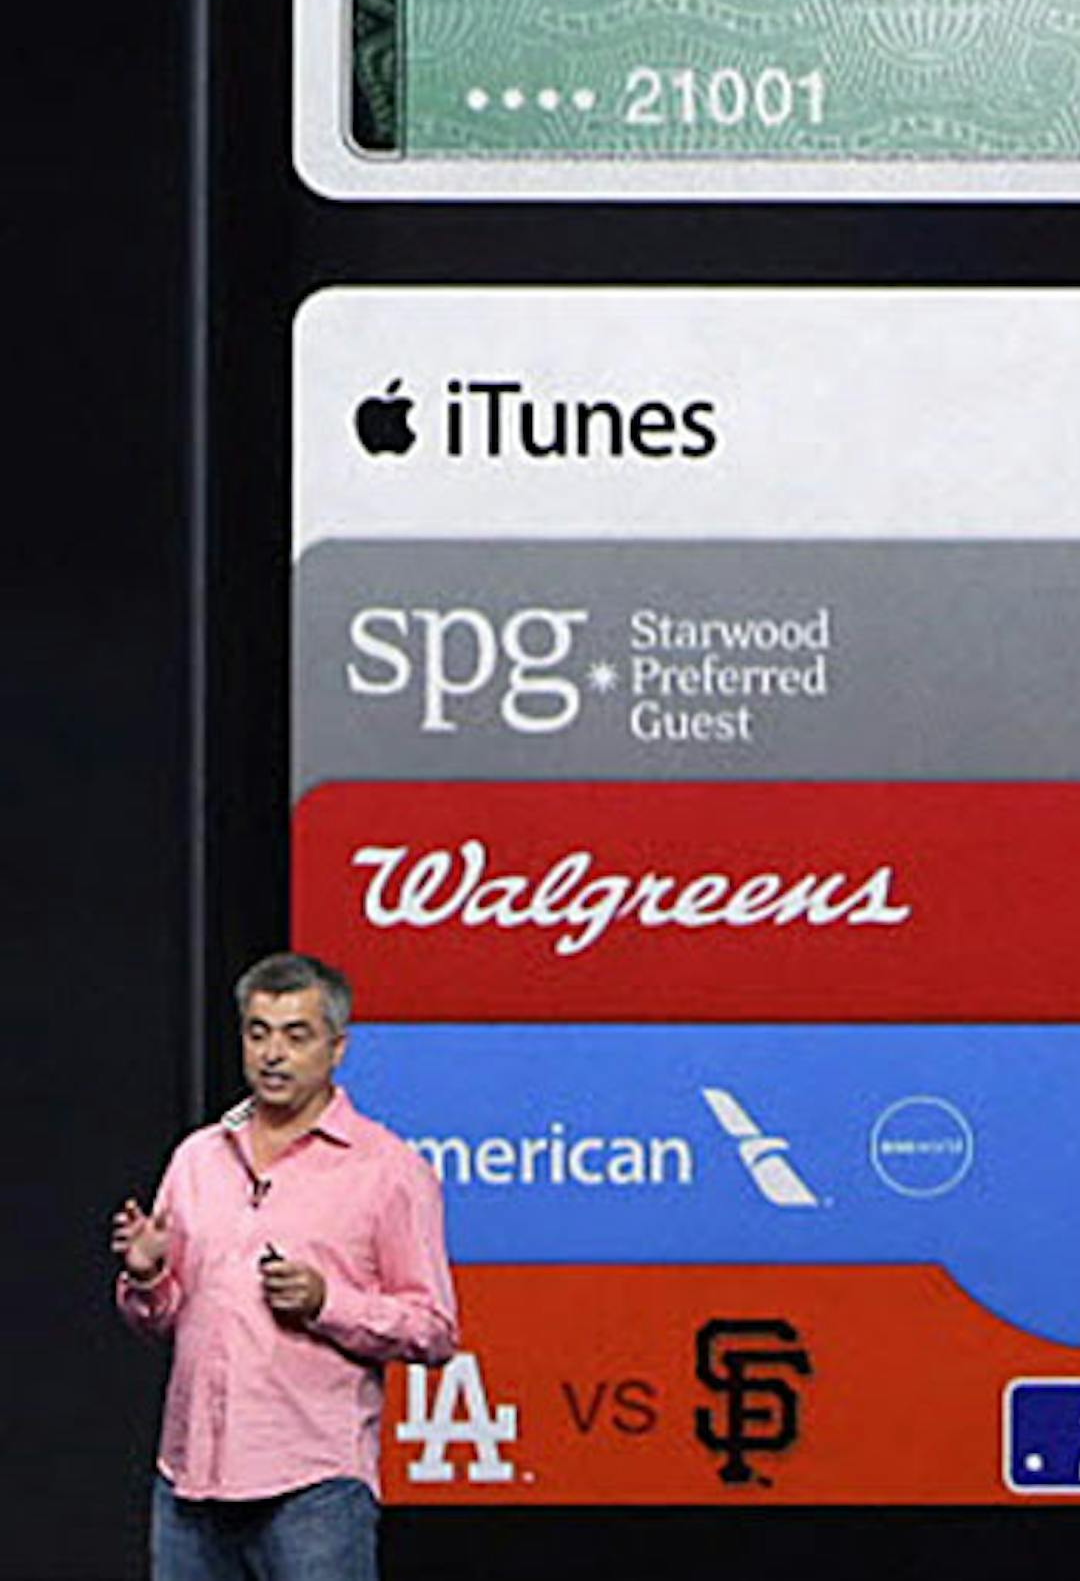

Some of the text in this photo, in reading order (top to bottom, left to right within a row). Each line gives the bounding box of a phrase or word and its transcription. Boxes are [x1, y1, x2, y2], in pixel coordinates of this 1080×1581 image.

[624, 67, 828, 126] 21001
[446, 379, 717, 459] iTunes
[631, 608, 830, 651] Starwood
[347, 608, 589, 733] spg
[631, 653, 828, 696] Preferred
[630, 699, 752, 742] Guest
[352, 840, 911, 955] Walgreens
[406, 1122, 693, 1185] merican
